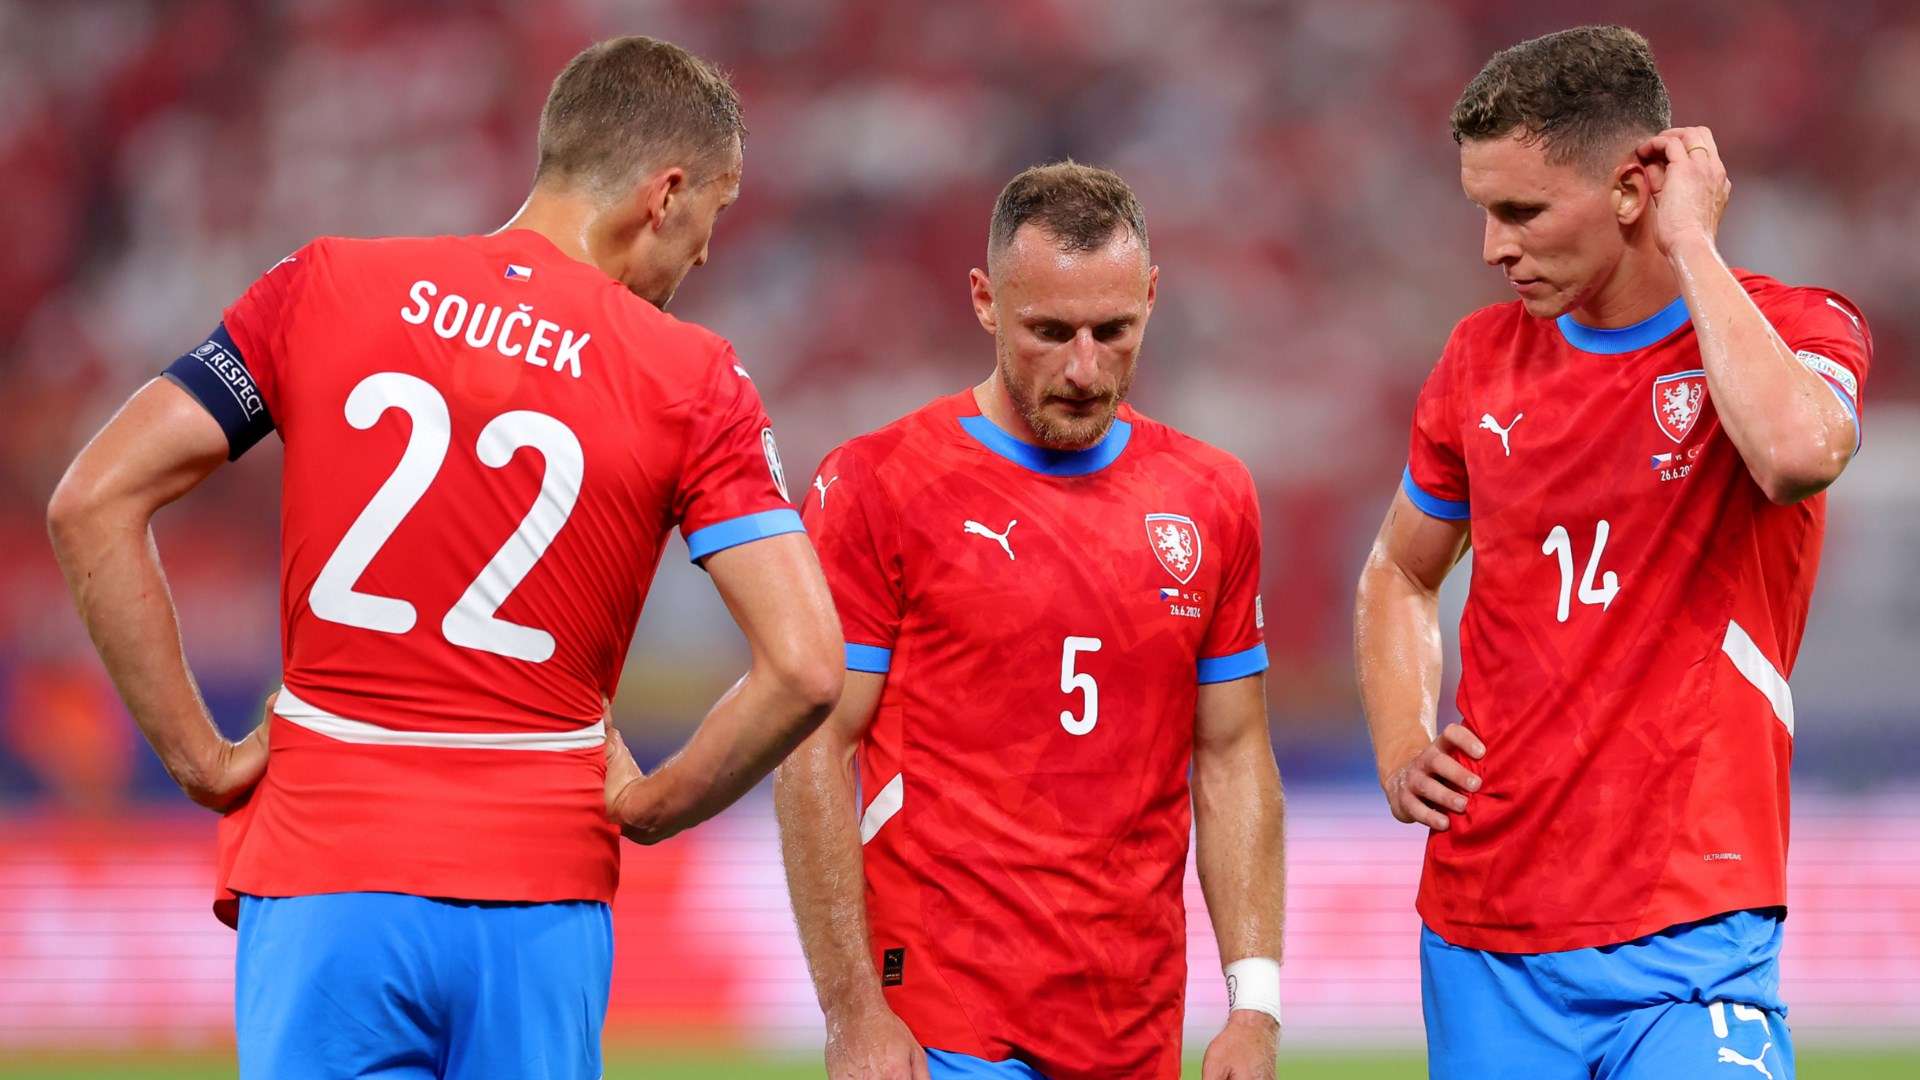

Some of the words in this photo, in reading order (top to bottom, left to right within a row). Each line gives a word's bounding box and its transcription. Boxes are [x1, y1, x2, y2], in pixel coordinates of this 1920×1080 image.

[400, 279, 592, 379] SOUČEK
[209, 352, 264, 415] RESPECT
[307, 371, 585, 664] 22
[1170, 604, 1201, 618] 26.6.2024
[1541, 519, 1621, 623] 14
[1059, 635, 1102, 736] 5
